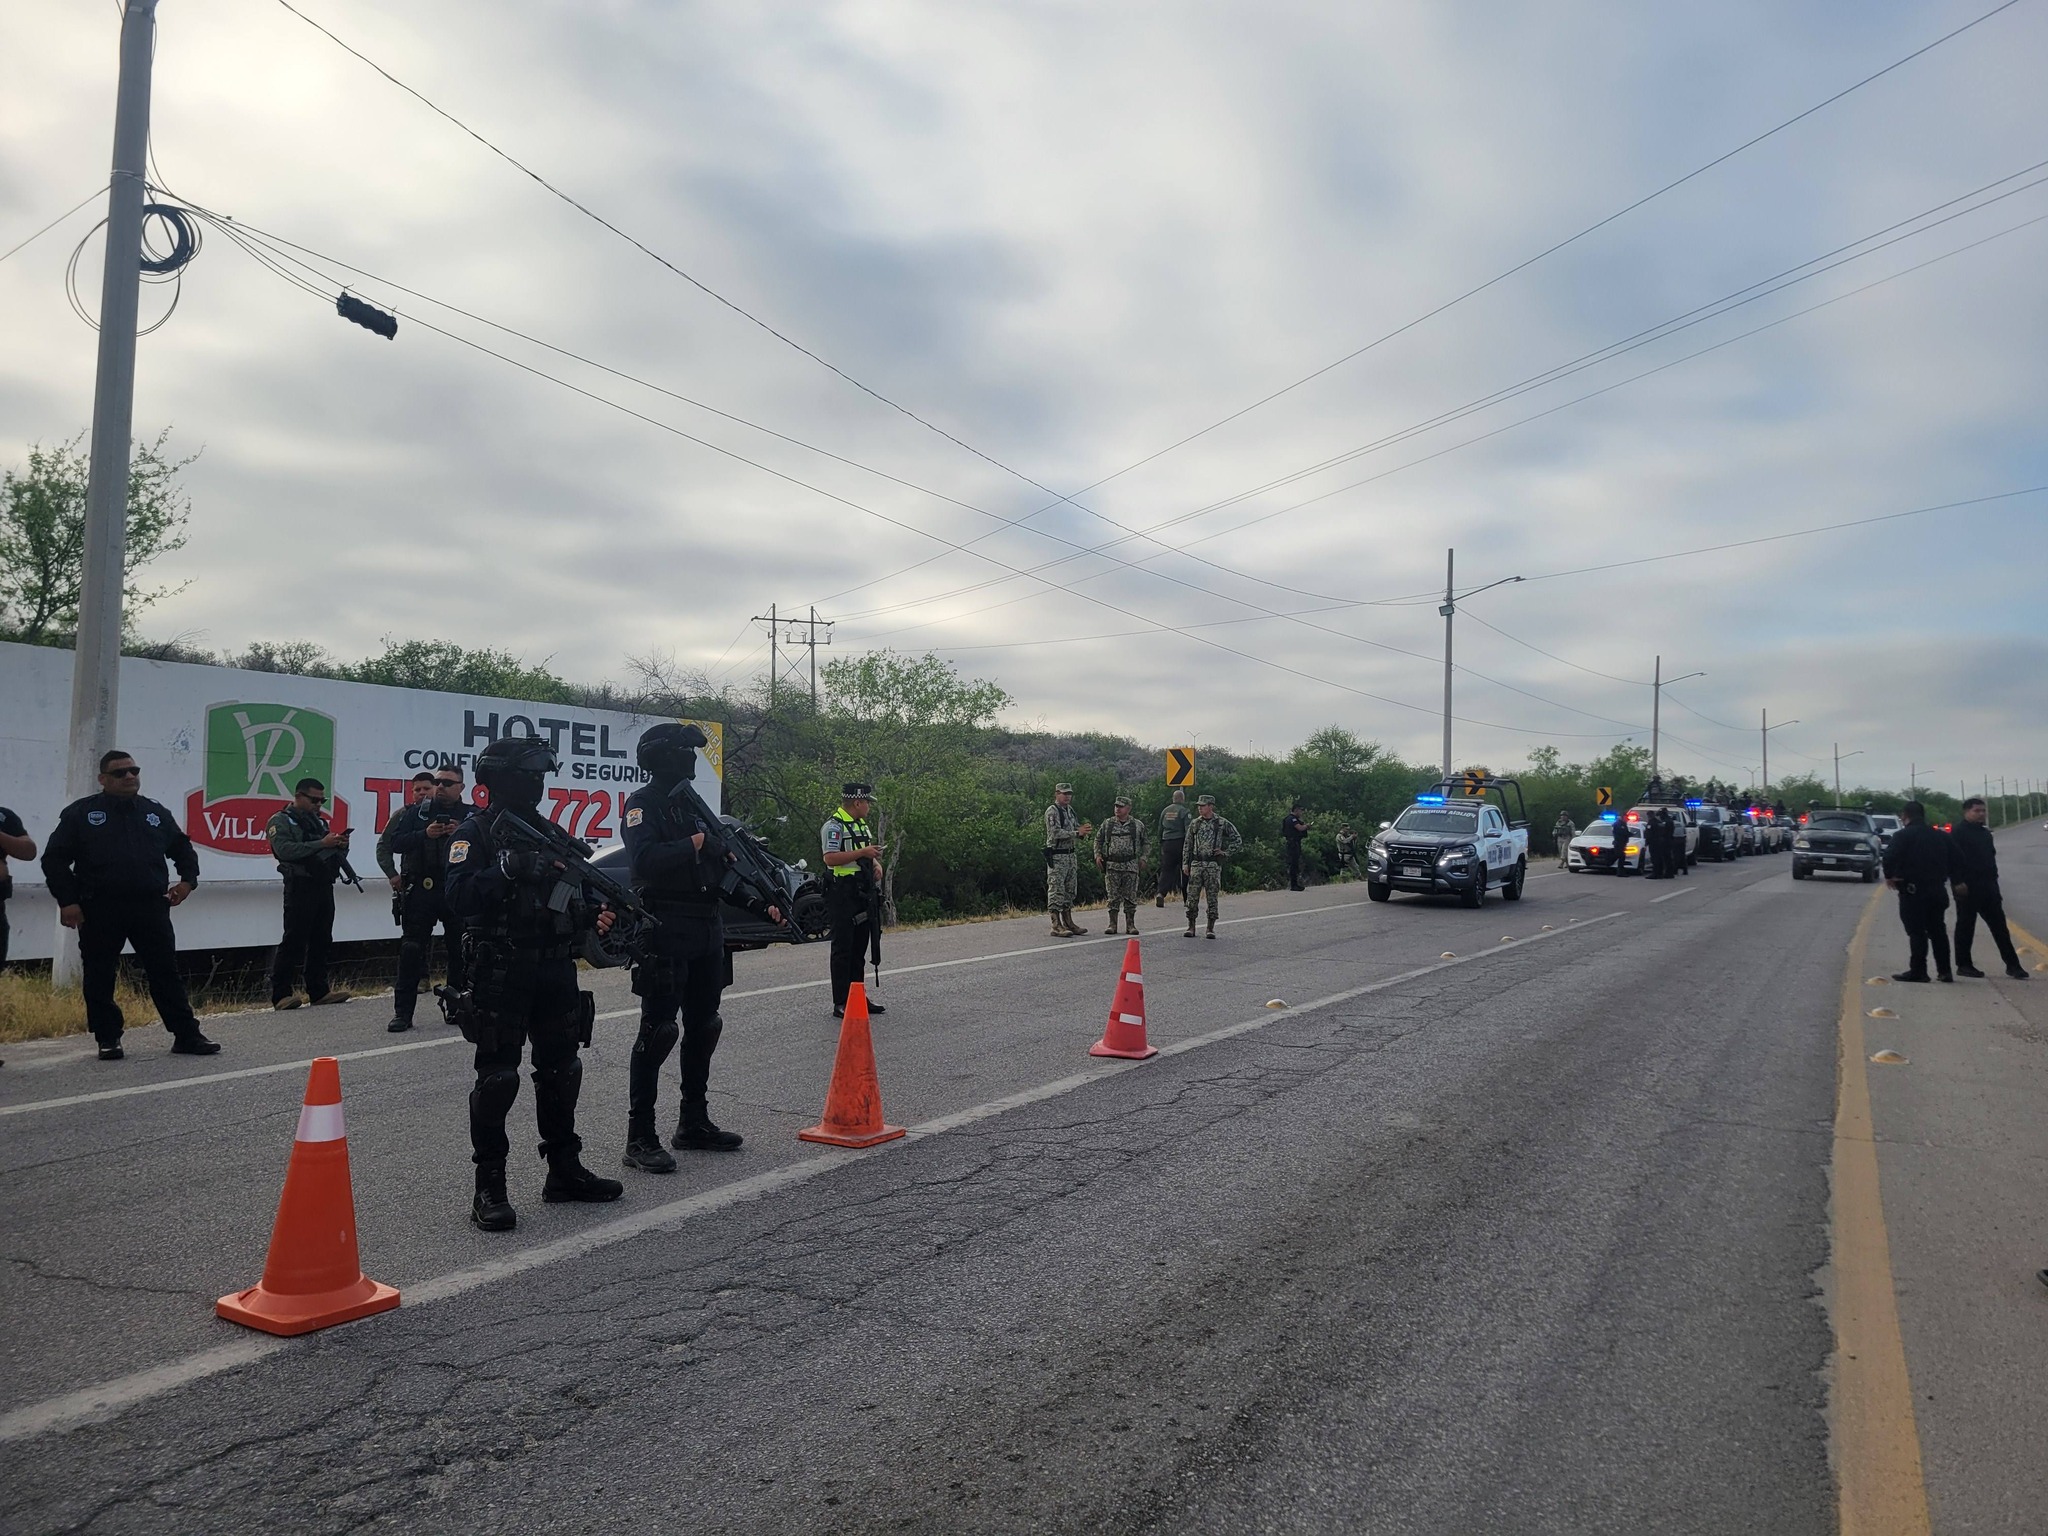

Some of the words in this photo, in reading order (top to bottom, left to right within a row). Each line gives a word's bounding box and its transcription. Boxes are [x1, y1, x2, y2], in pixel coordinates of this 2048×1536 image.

[464, 709, 628, 759] HOTEL
[571, 762, 651, 783] SEGURID
[548, 787, 613, 838] 772
